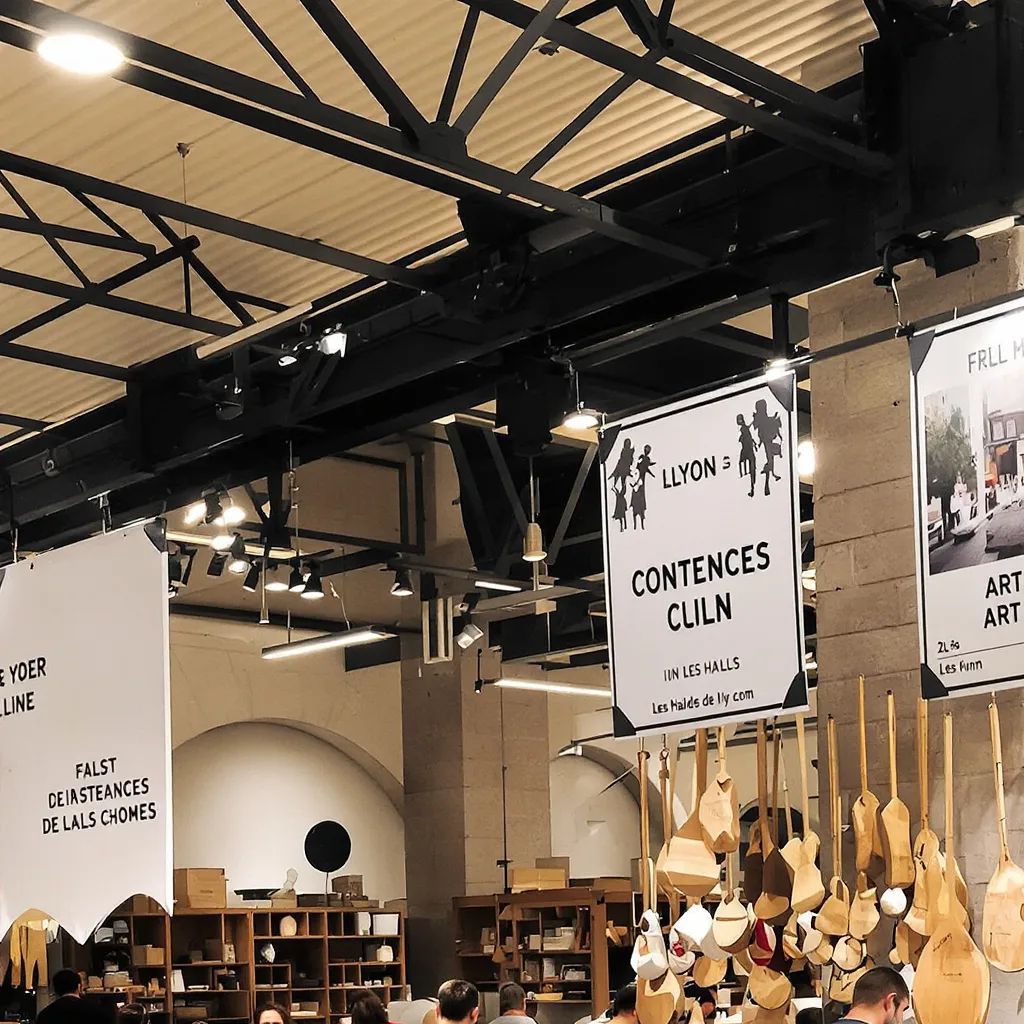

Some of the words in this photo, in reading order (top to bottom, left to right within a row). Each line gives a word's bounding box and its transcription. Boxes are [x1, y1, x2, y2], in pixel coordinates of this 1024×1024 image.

[662, 455, 717, 489] LLYON
[631, 541, 771, 598] CONTENCES
[985, 569, 1022, 599] ART
[984, 602, 1021, 629] ART
[9, 656, 47, 685] YOER
[683, 663, 702, 679] LES
[704, 656, 741, 675] HALLS
[702, 693, 715, 706] de
[732, 689, 755, 703] com
[76, 757, 118, 780] FALST
[42, 814, 60, 835] DE
[62, 808, 97, 833] LALS
[101, 802, 158, 827] CHOMES
